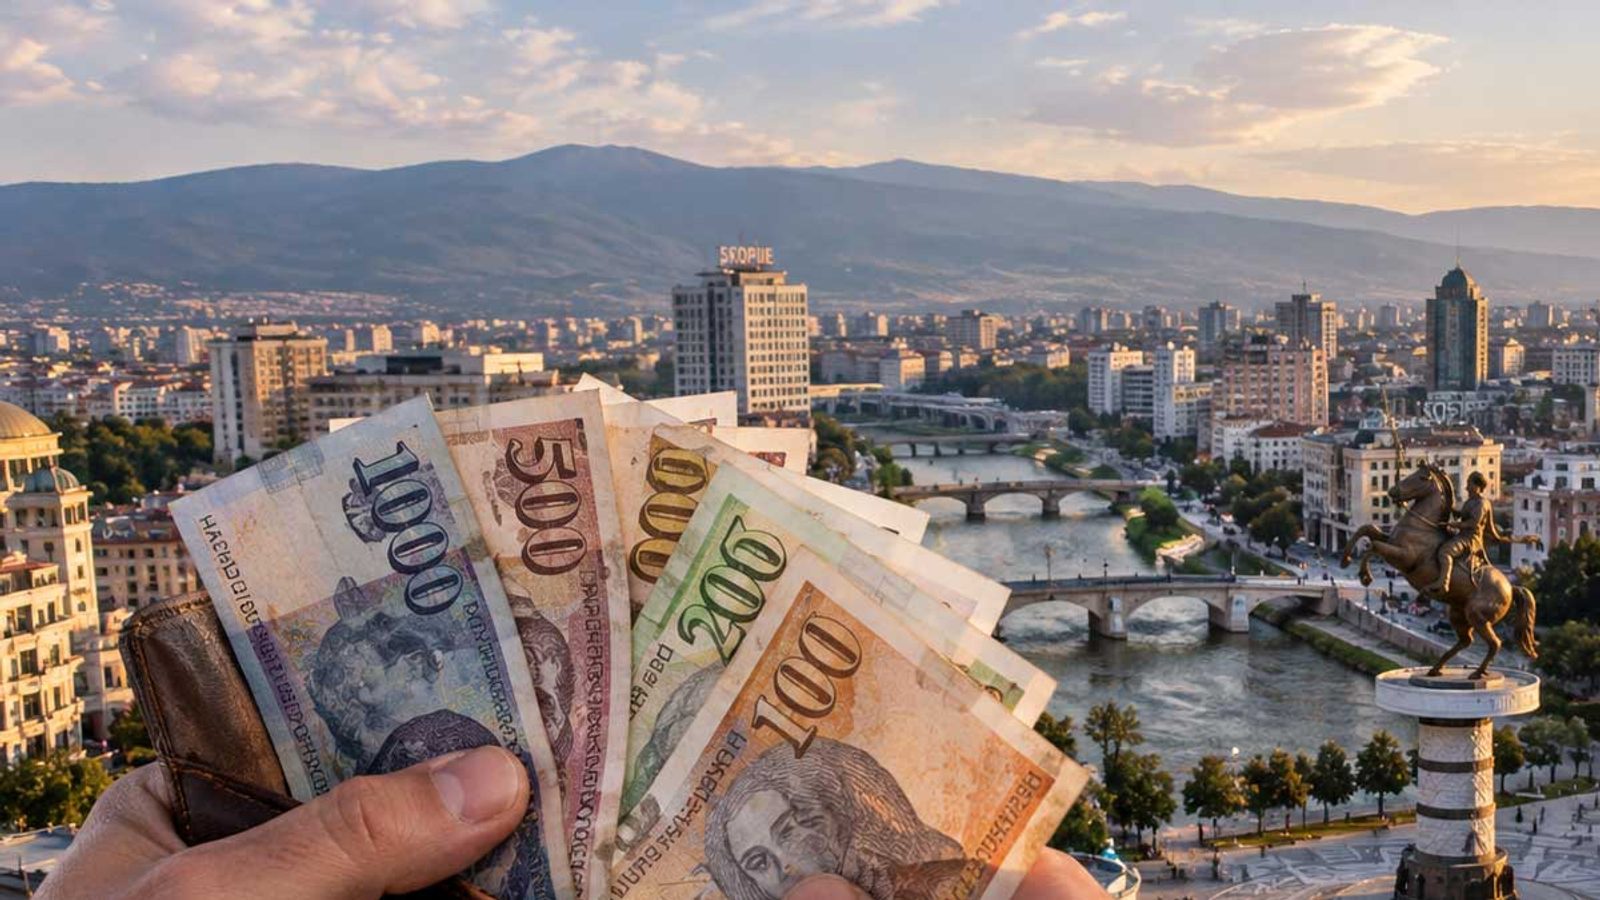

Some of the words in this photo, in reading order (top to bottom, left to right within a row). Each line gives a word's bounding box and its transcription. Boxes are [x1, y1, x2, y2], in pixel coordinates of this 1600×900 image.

[353, 440, 464, 615] 1000
[505, 437, 588, 576] 500
[752, 611, 863, 759] 100
